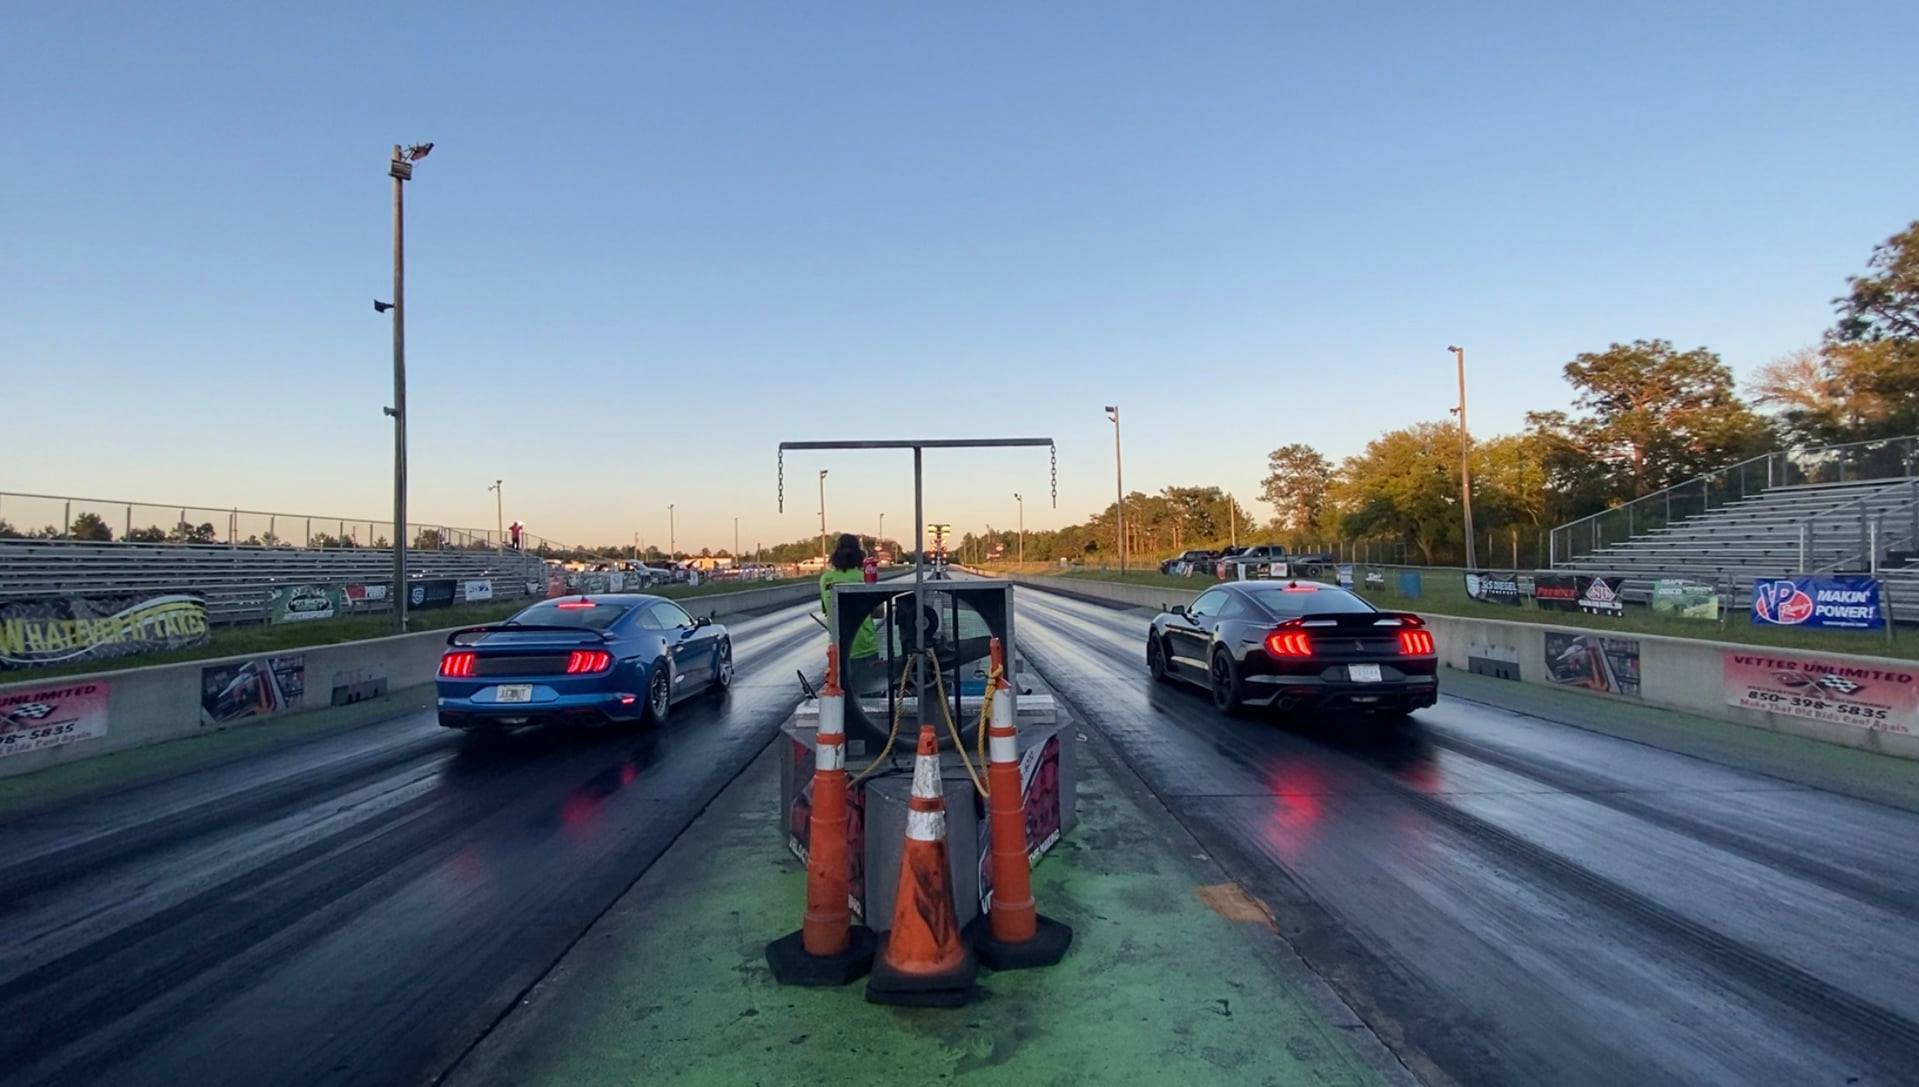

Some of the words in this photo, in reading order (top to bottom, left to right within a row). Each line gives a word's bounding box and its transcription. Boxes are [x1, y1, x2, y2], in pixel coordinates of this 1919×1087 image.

[1817, 590, 1871, 603] MAKIN'
[1815, 605, 1874, 619] POWER!
[1734, 655, 1798, 671] VETTES
[1803, 662, 1913, 685] UNLIMITED
[1837, 704, 1889, 720] 5835
[29, 723, 76, 740] 5835
